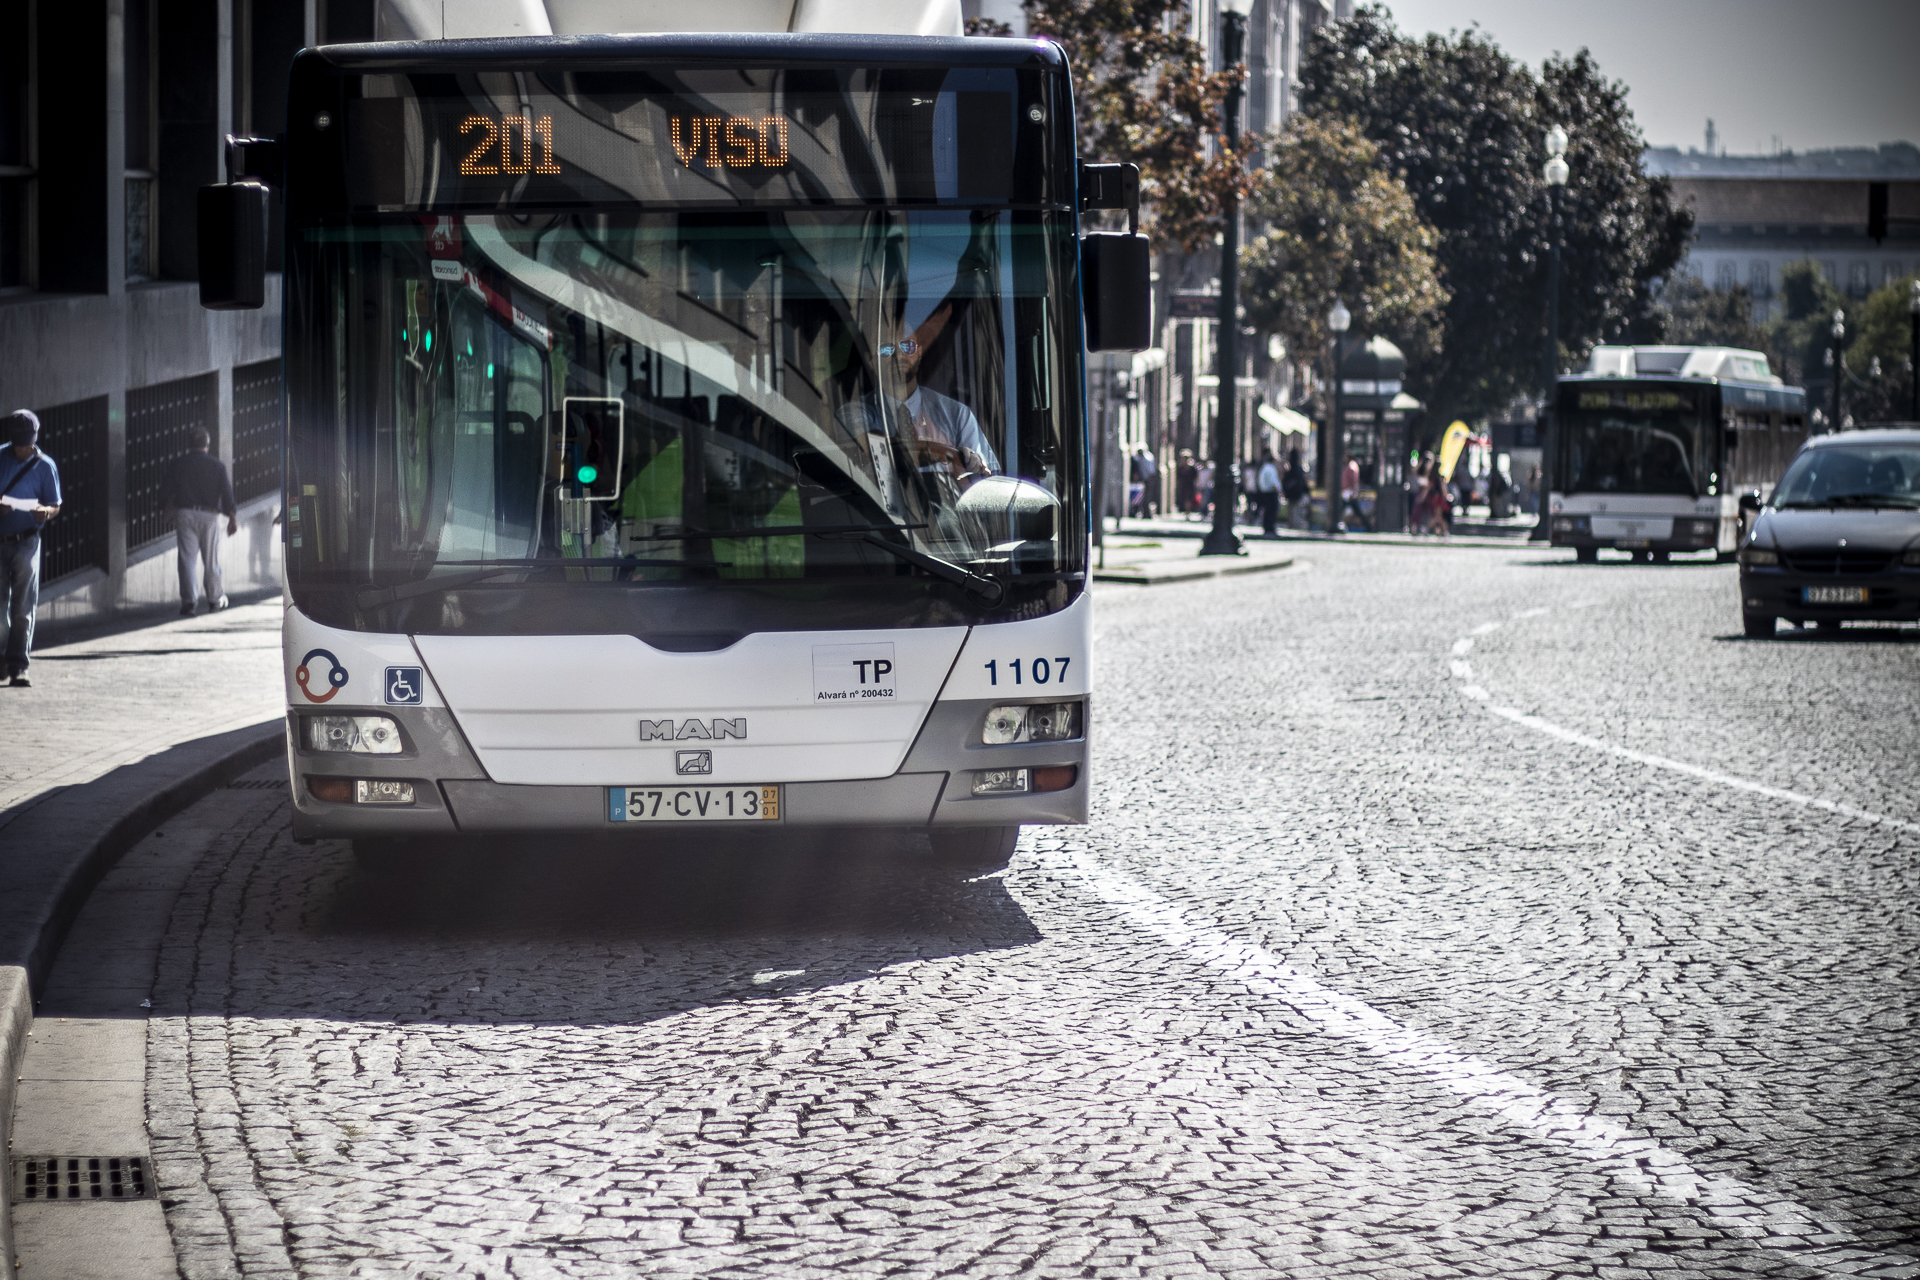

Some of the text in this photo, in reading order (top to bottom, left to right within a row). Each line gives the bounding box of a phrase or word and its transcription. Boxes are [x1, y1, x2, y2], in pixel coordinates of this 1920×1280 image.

[460, 116, 788, 175] 201 VISO
[852, 659, 892, 684] TP
[984, 657, 1071, 686] 1107
[817, 688, 847, 700] Alvará
[861, 688, 894, 698] 200432
[640, 718, 747, 741] MAN
[762, 789, 776, 799] 07
[615, 808, 621, 816] P
[762, 806, 776, 816] 01
